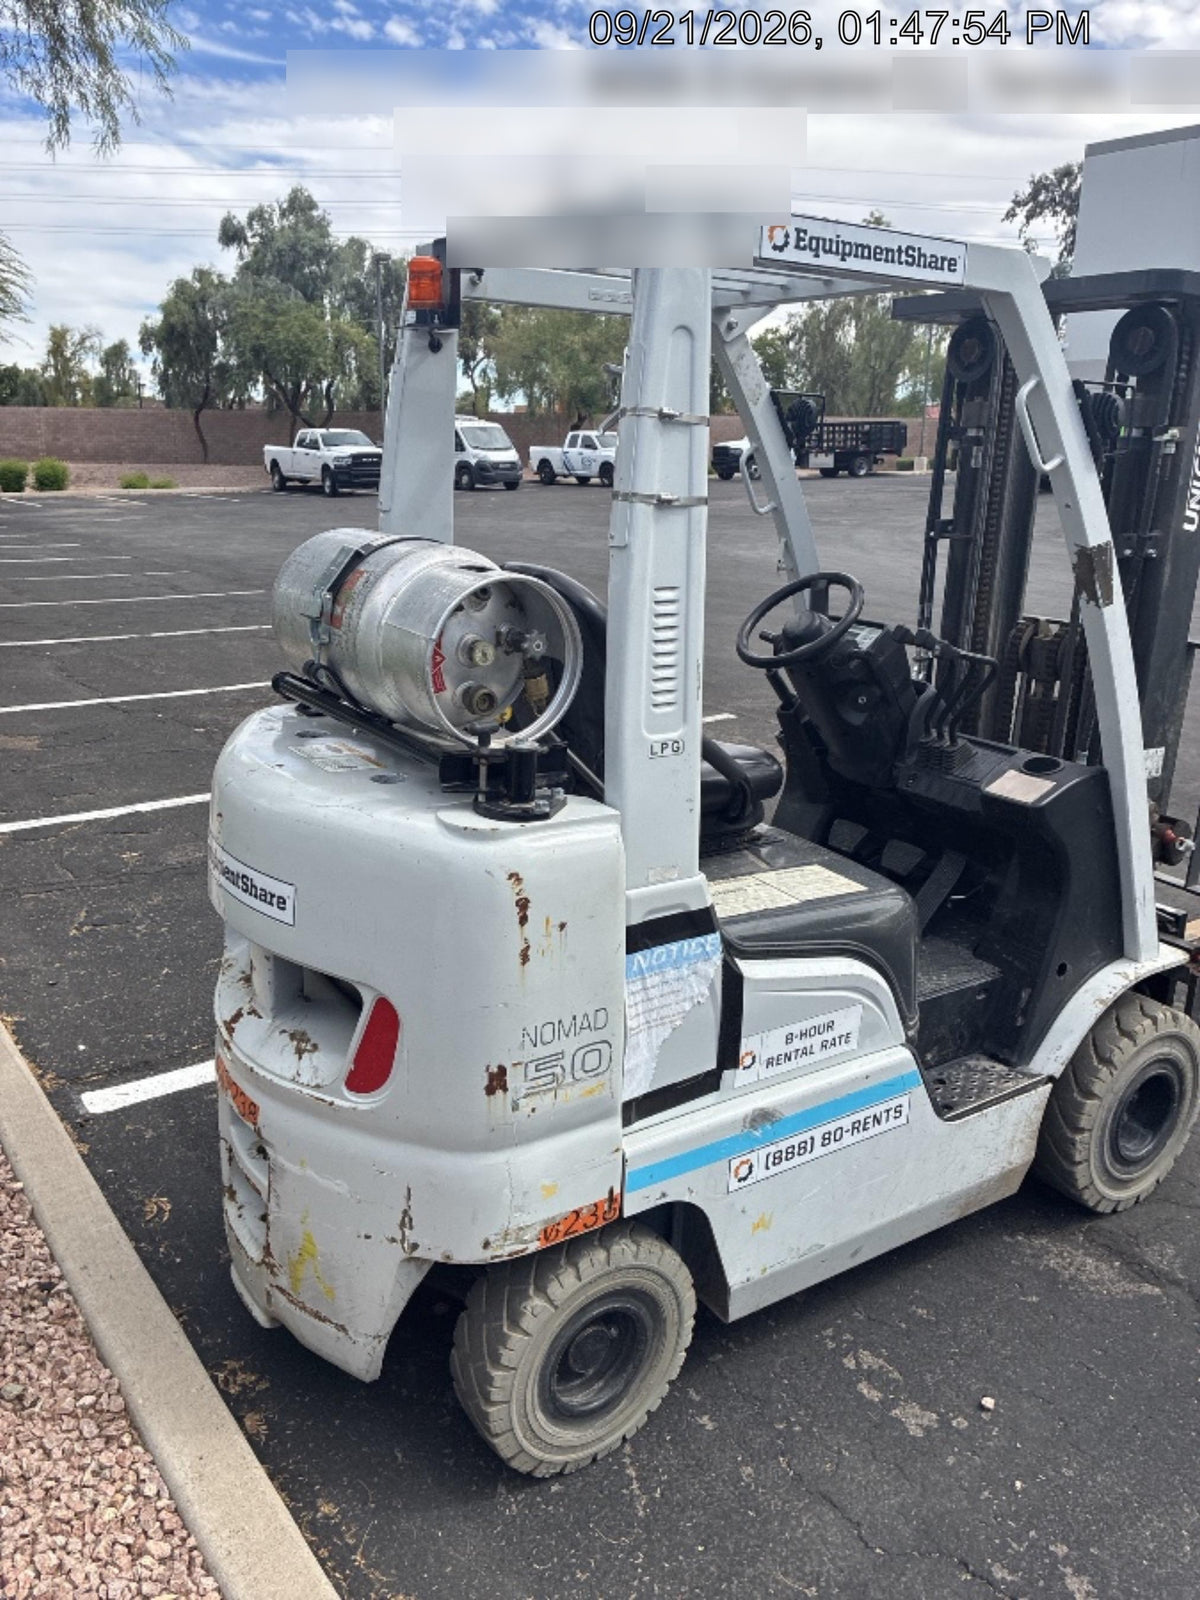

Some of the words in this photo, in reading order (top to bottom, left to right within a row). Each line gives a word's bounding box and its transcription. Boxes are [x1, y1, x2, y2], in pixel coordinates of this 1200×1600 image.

[794, 227, 958, 273] EquipmentShare
[650, 740, 681, 756] LPG
[633, 933, 722, 974] NOTICE
[522, 1006, 609, 1050] NOMAD
[785, 1020, 835, 1046] 8-HOUR
[521, 1039, 613, 1098] 50
[765, 1044, 815, 1069] RENTAL
[820, 1032, 852, 1052] RATE
[764, 1136, 815, 1170] (888)
[820, 1103, 903, 1147] 80-RENTS
